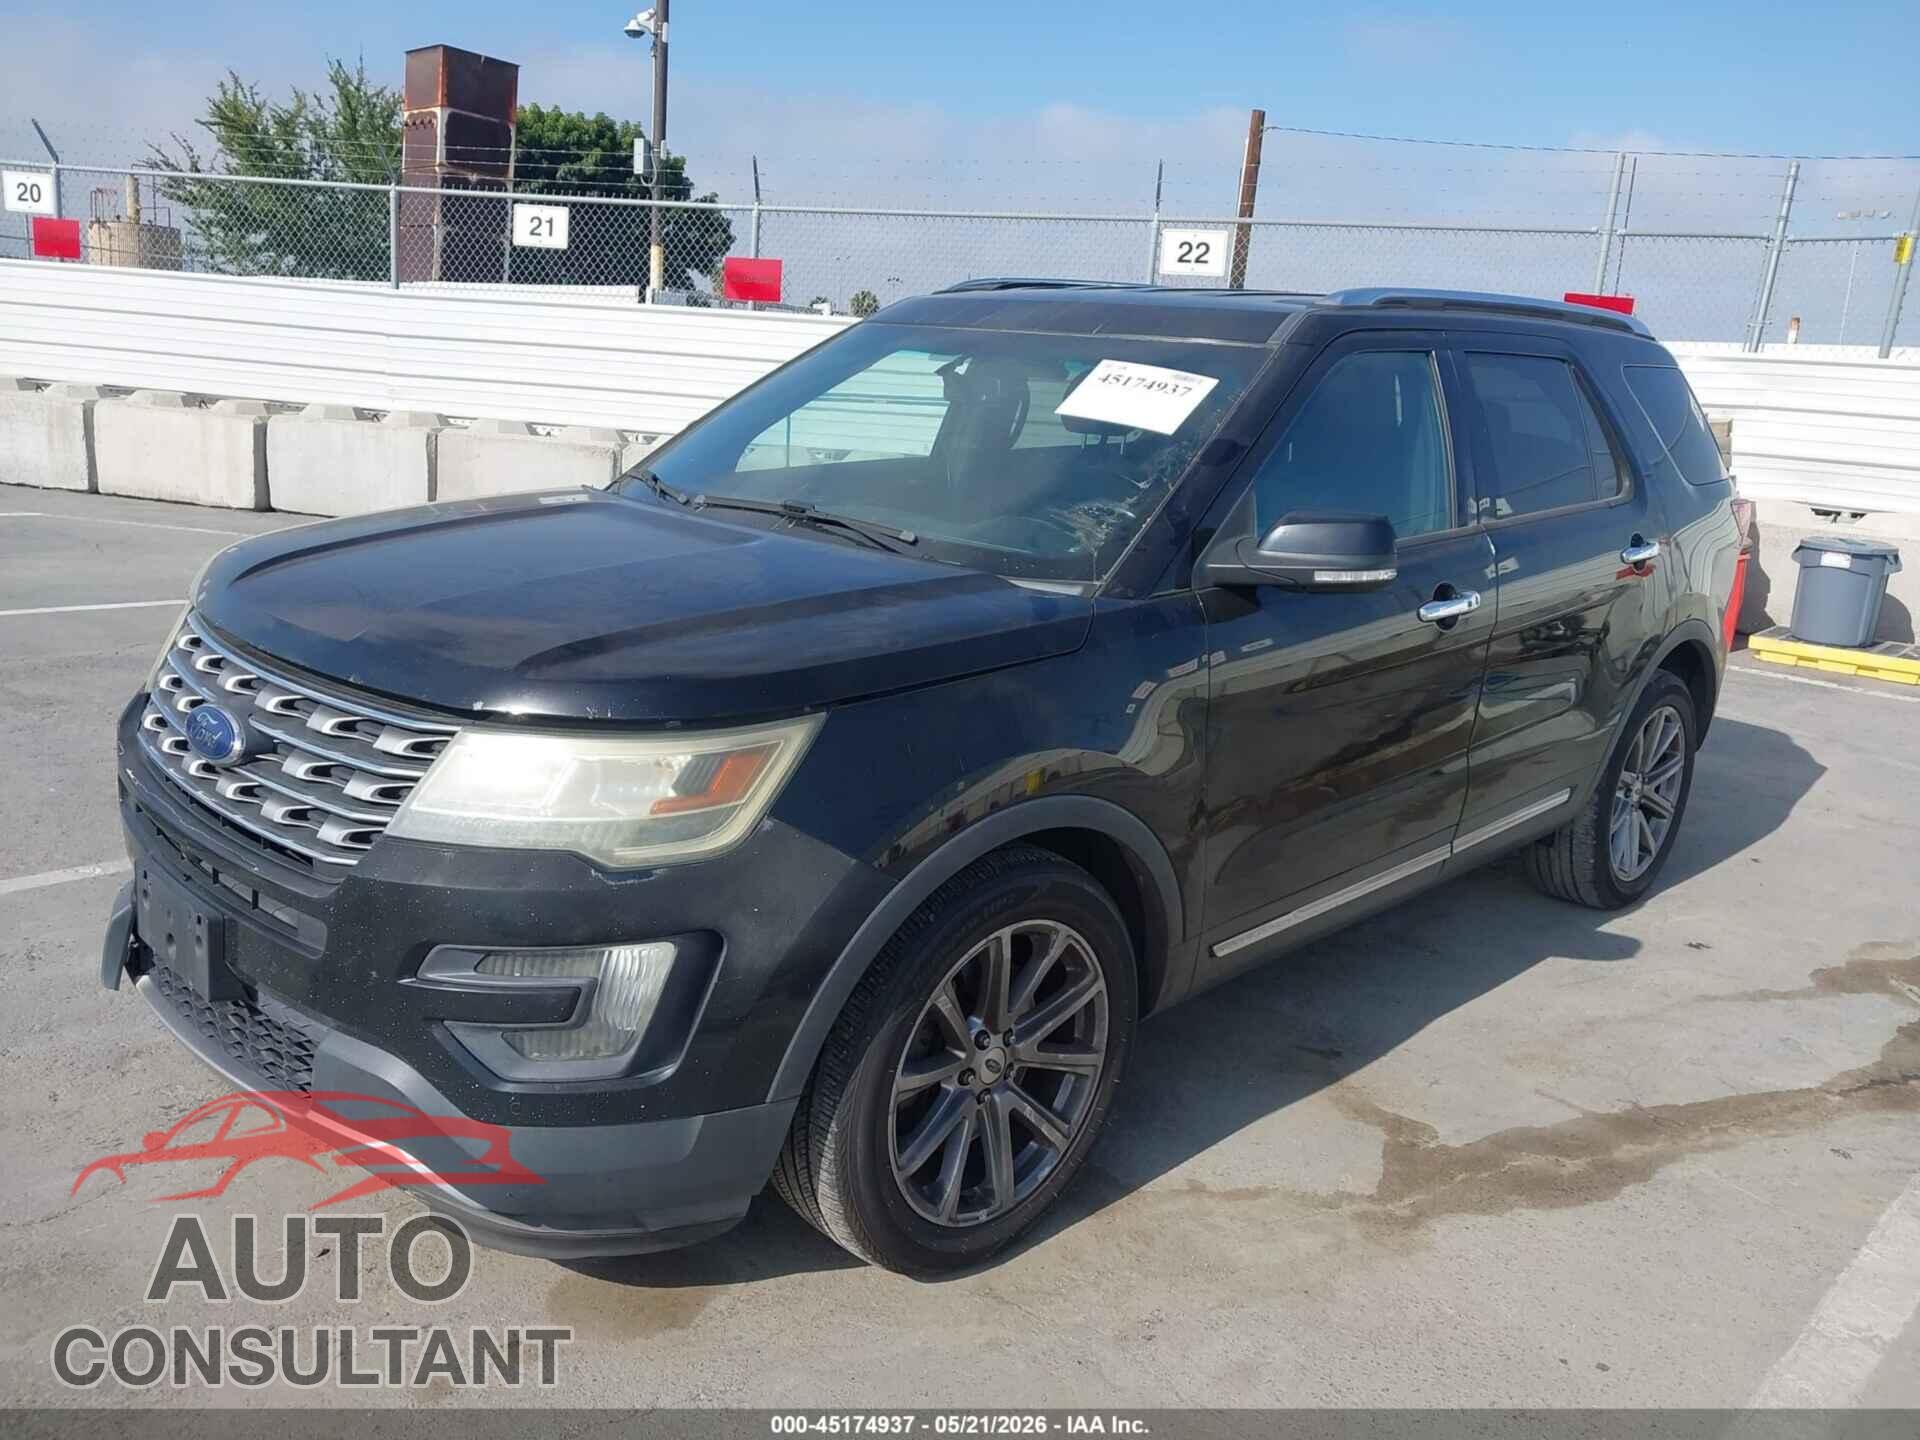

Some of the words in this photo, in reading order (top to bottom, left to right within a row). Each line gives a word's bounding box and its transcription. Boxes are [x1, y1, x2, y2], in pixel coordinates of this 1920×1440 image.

[17, 182, 41, 203] 20
[529, 216, 553, 237] 21
[1177, 241, 1210, 264] 22
[1097, 373, 1193, 397] 45174937
